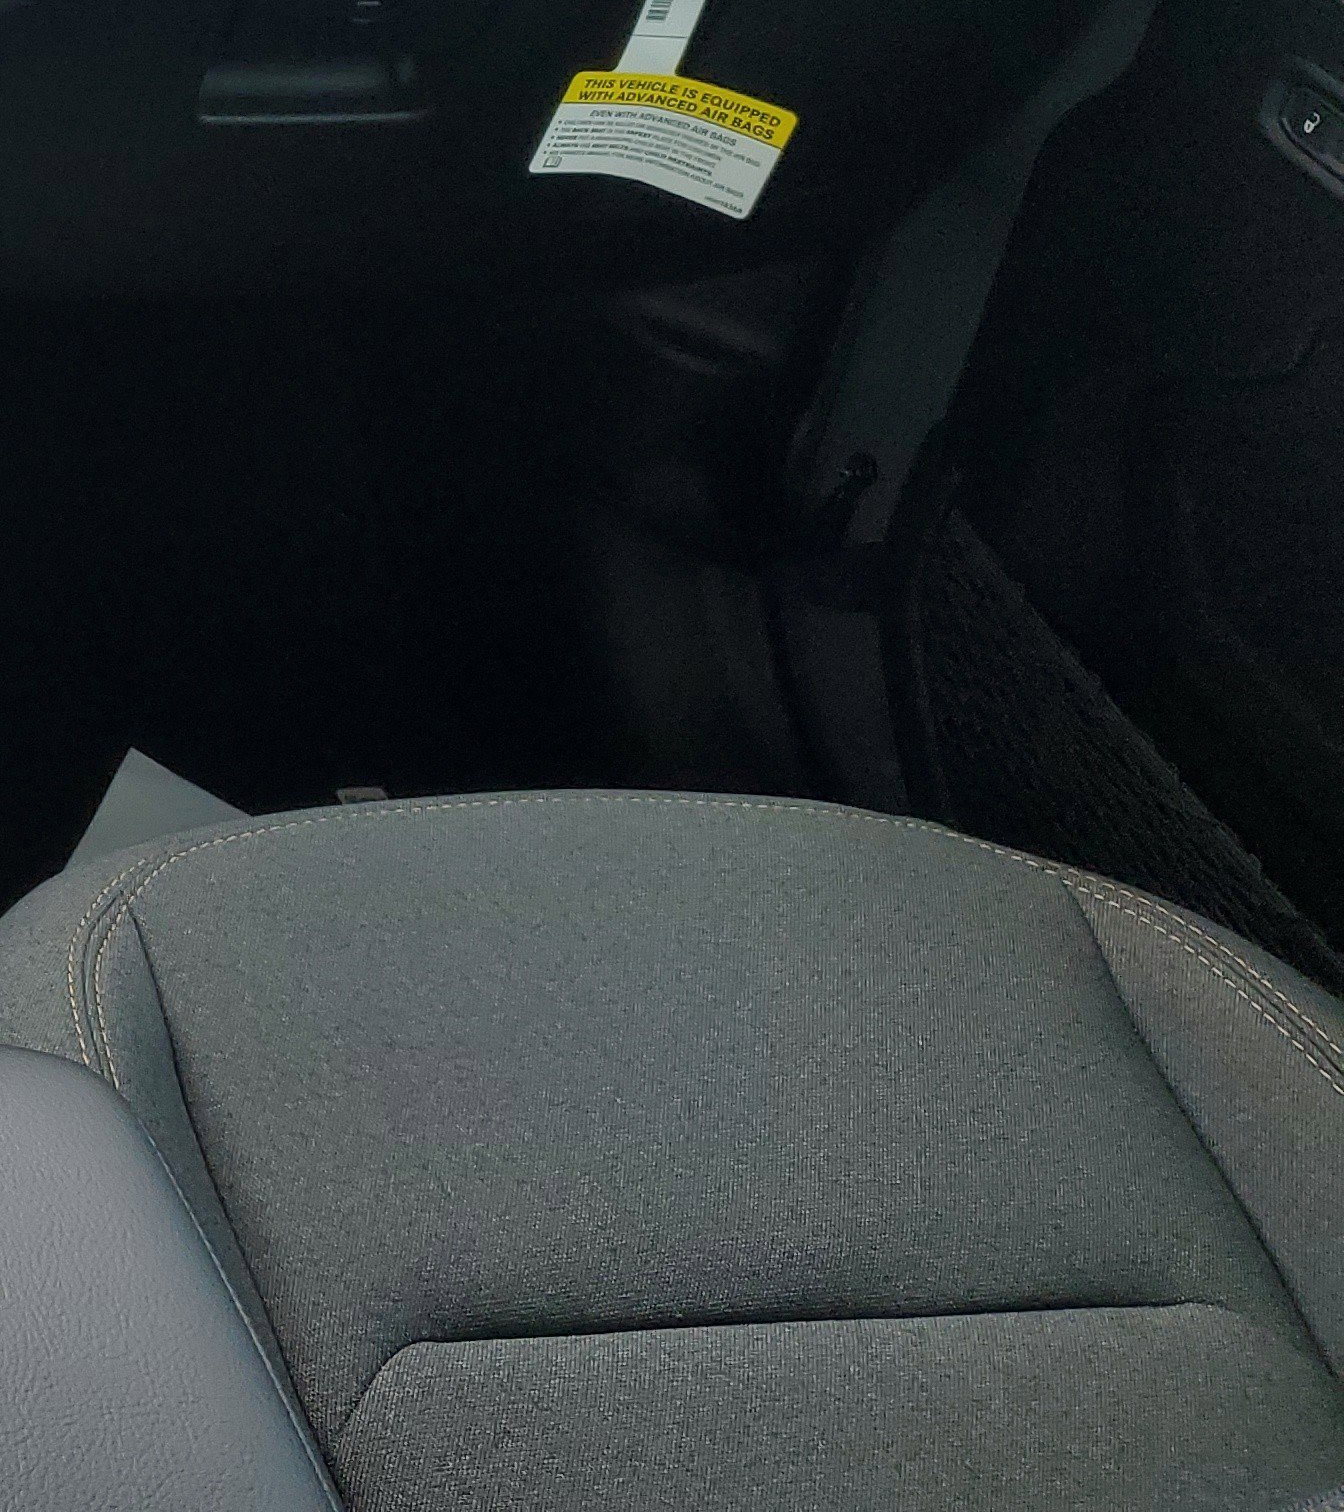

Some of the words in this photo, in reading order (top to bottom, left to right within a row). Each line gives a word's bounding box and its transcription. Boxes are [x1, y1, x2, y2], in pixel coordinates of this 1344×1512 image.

[578, 89, 613, 101] WITH
[615, 91, 699, 113] ADVANCED
[701, 107, 730, 124] AIR
[730, 118, 776, 141] BAGS
[584, 78, 615, 90] THIS
[618, 79, 677, 96] VEHICLE
[681, 87, 700, 99] IS
[700, 92, 782, 128] EQUIPPED
[638, 112, 691, 131] ADVANCED
